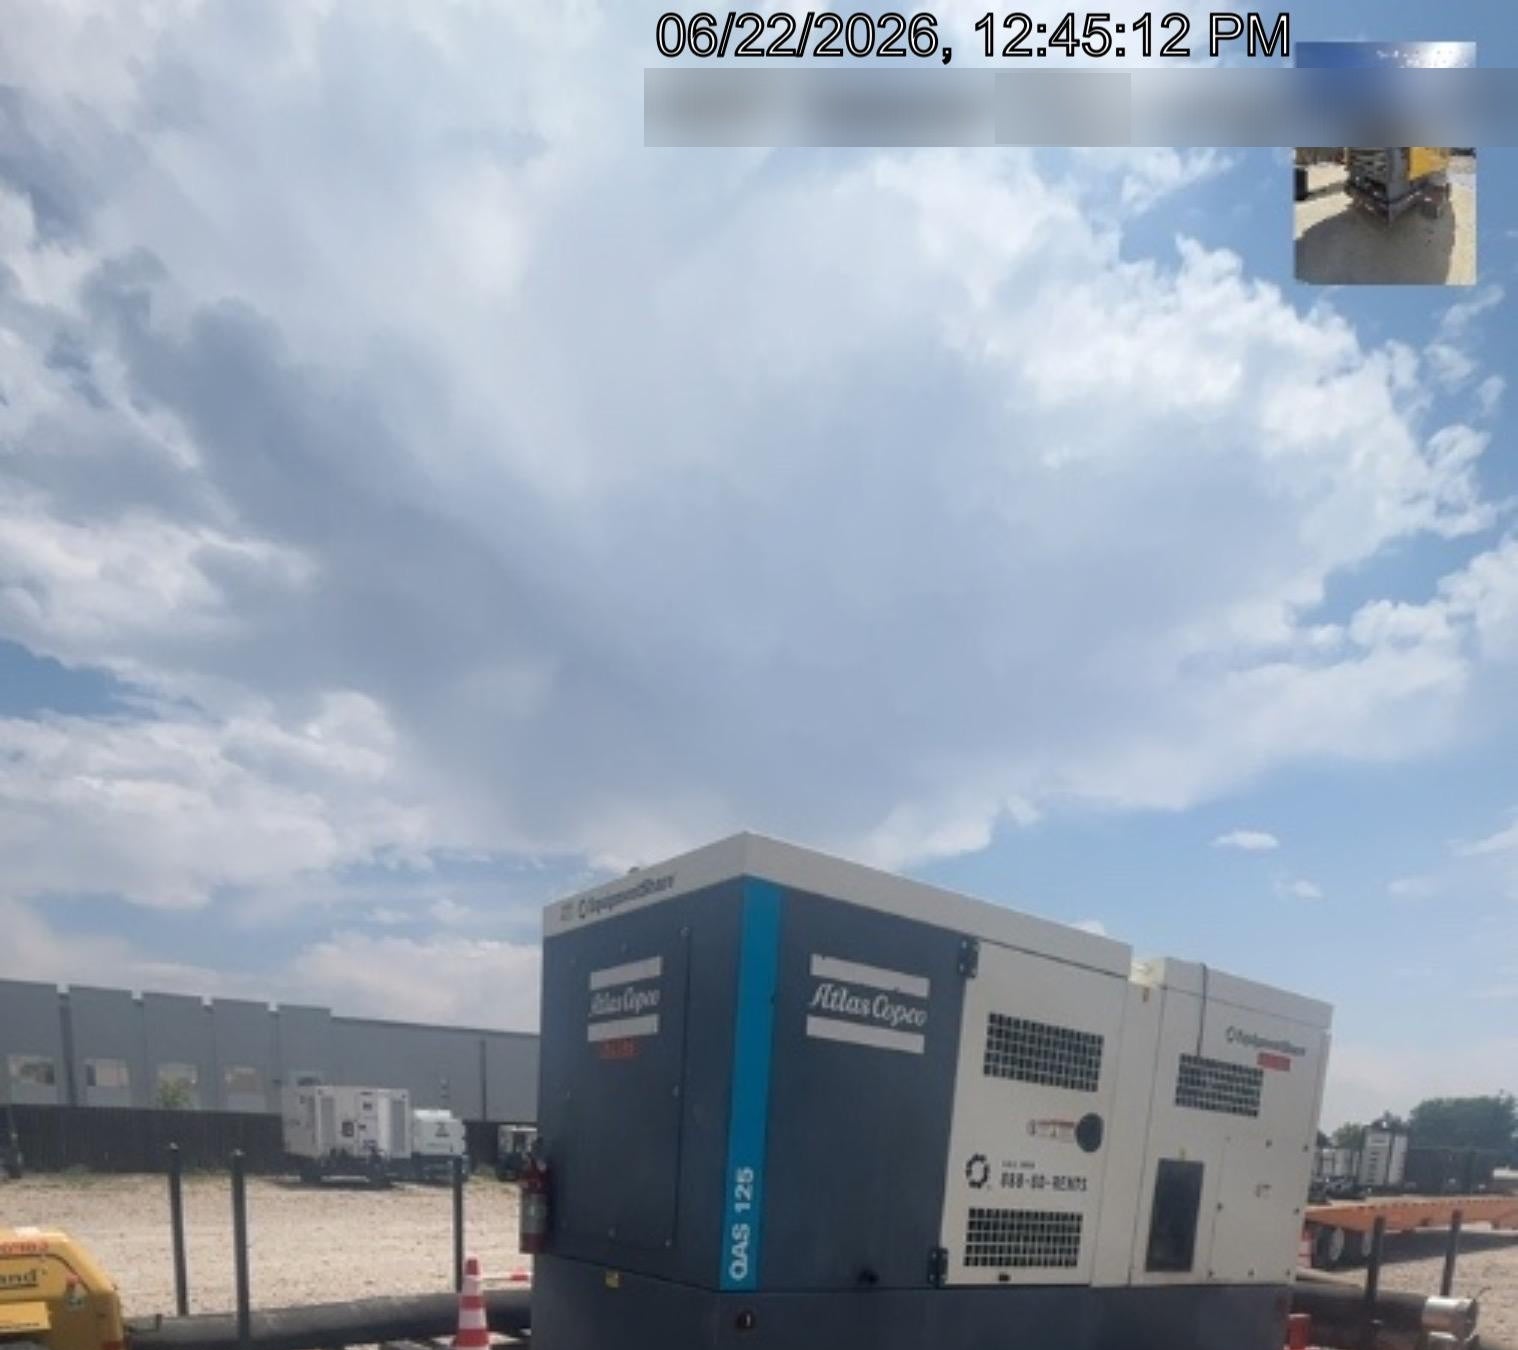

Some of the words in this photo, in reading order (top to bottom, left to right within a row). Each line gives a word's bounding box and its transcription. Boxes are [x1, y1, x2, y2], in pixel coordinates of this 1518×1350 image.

[808, 983, 871, 1017] Atlas
[872, 993, 927, 1027] Copco
[734, 1166, 754, 1213] 125
[728, 1223, 750, 1280] QAS
